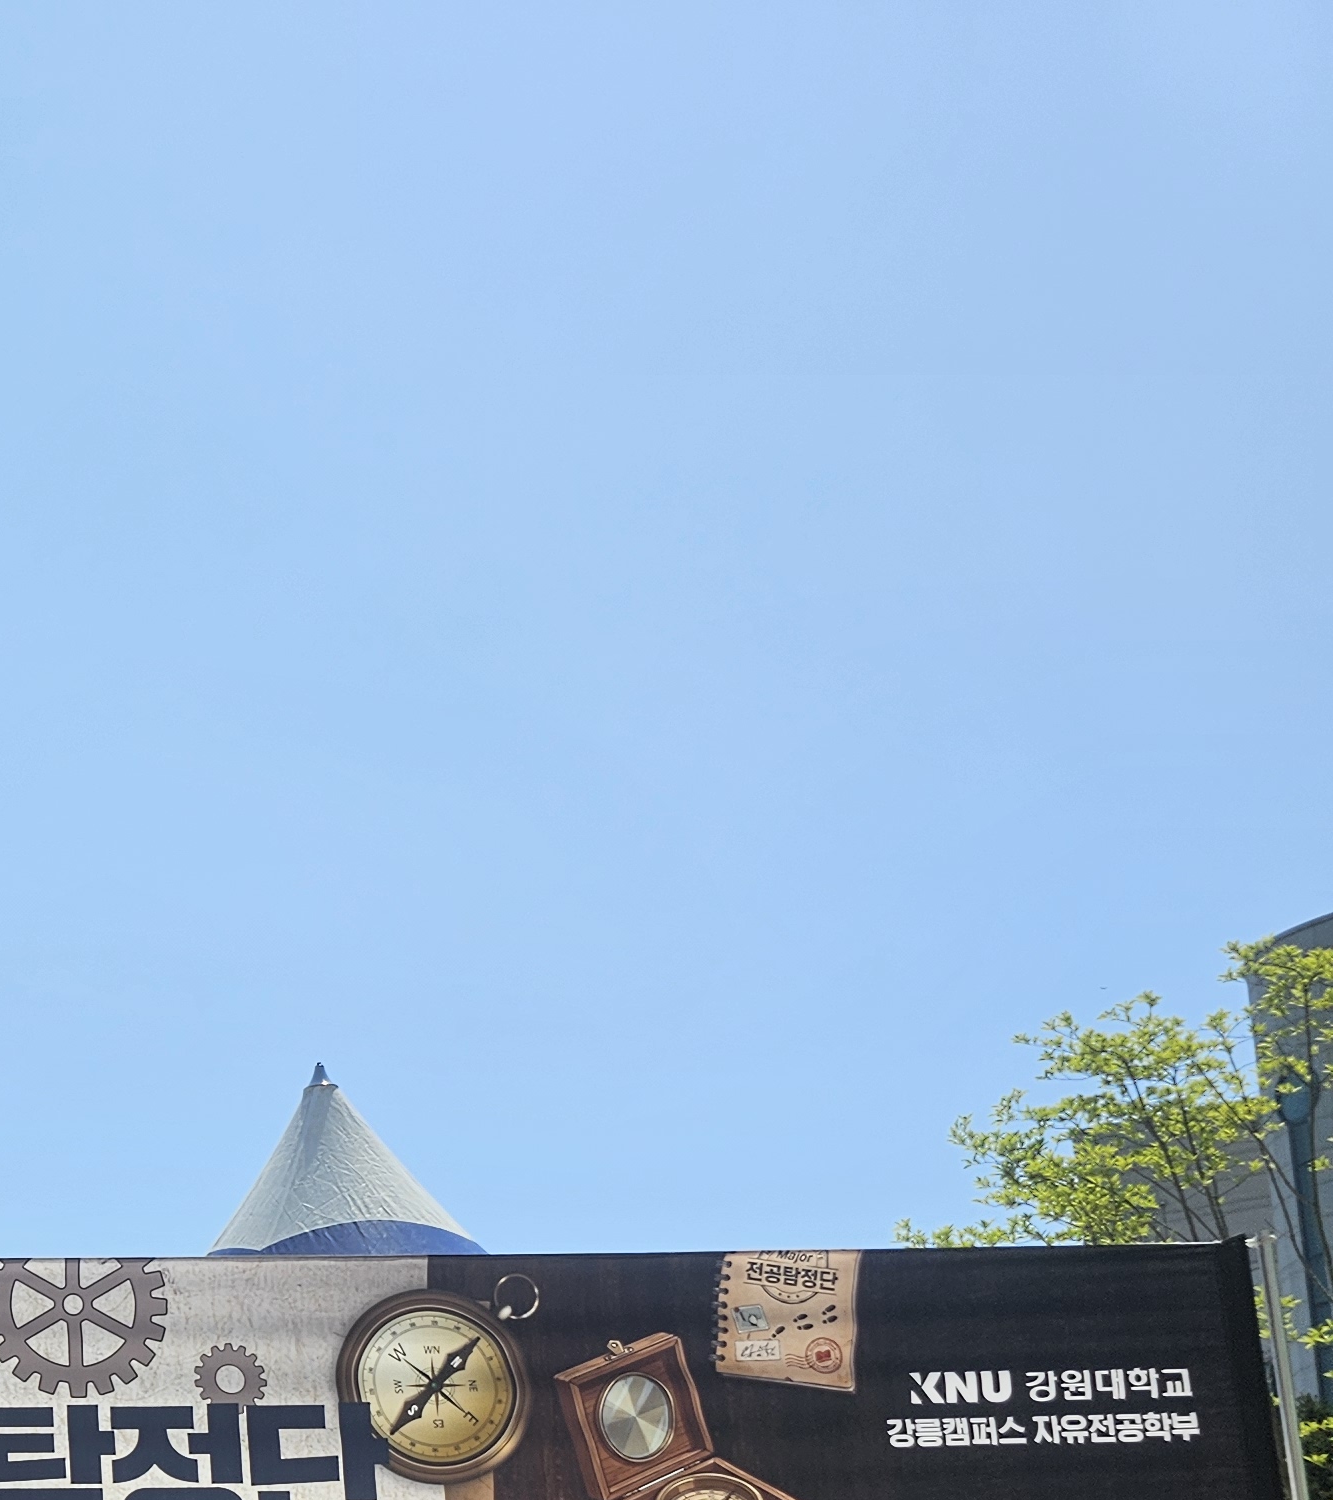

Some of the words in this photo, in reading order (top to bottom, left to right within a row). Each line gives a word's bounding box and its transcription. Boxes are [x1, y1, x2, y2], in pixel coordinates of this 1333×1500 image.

[776, 1250, 814, 1264] Major
[745, 1260, 839, 1292] 전공탐정단
[388, 1343, 407, 1362] W
[423, 1345, 440, 1355] WN
[468, 1379, 478, 1392] NE
[908, 1370, 1013, 1405] KNU
[1024, 1367, 1193, 1402] 강원대학교
[407, 1404, 418, 1416] S
[885, 1416, 1027, 1448] 강릉캠퍼스
[1031, 1411, 1200, 1445] 자유전공학부
